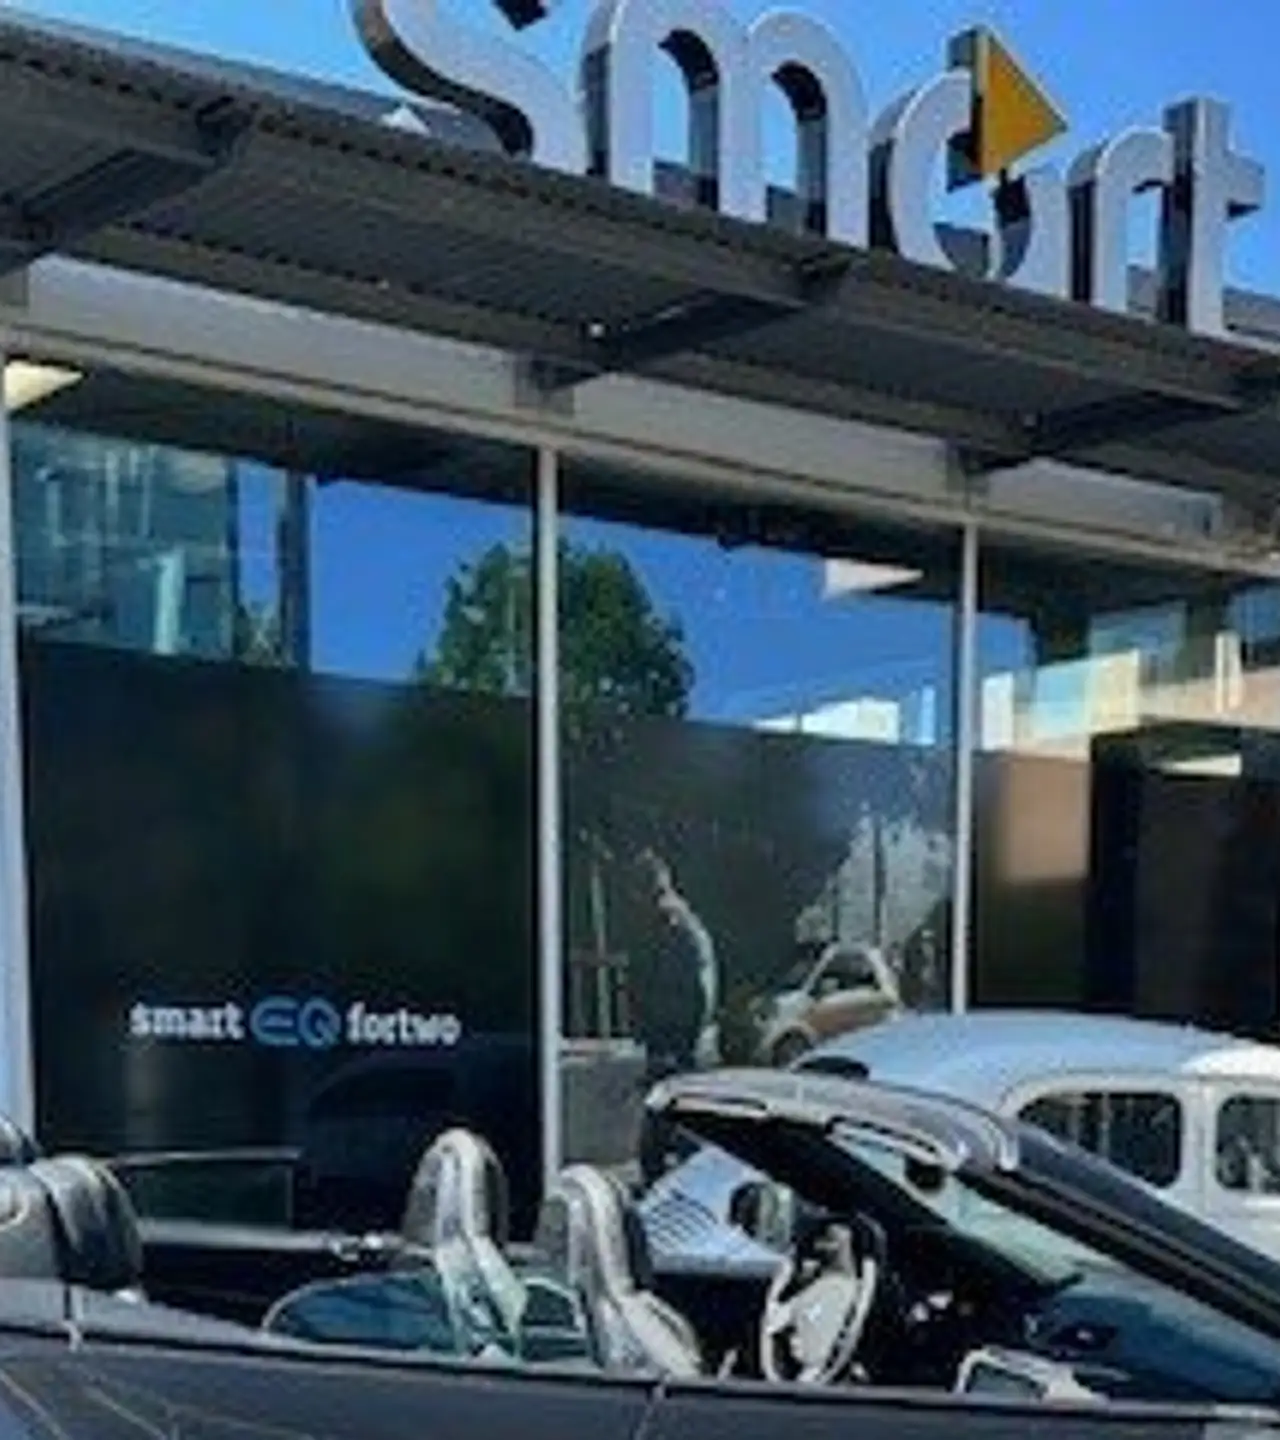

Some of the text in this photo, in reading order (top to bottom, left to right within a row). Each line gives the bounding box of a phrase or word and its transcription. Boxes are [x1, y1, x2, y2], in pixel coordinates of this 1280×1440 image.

[129, 996, 462, 1049] smart EQ fortwo
